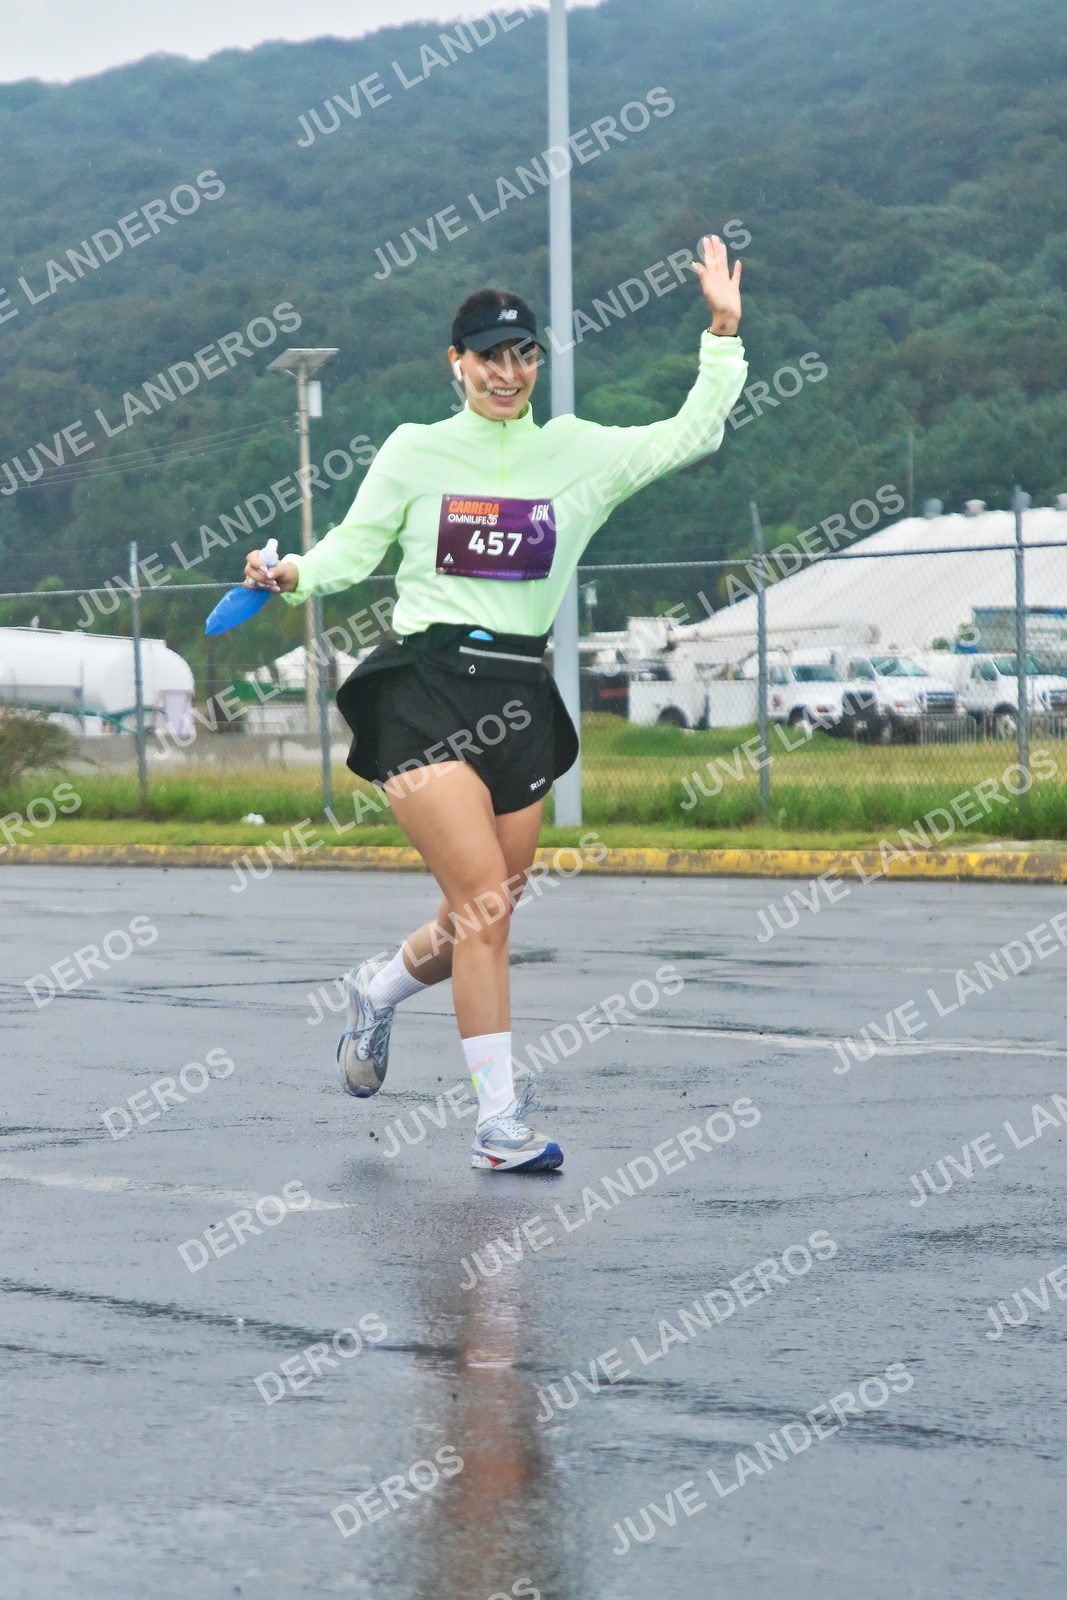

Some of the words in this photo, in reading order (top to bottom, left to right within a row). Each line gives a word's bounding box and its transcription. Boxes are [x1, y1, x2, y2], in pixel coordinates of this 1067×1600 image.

[448, 500, 500, 515] CARRERA
[468, 530, 523, 556] 457
[530, 776, 546, 791] RUN
